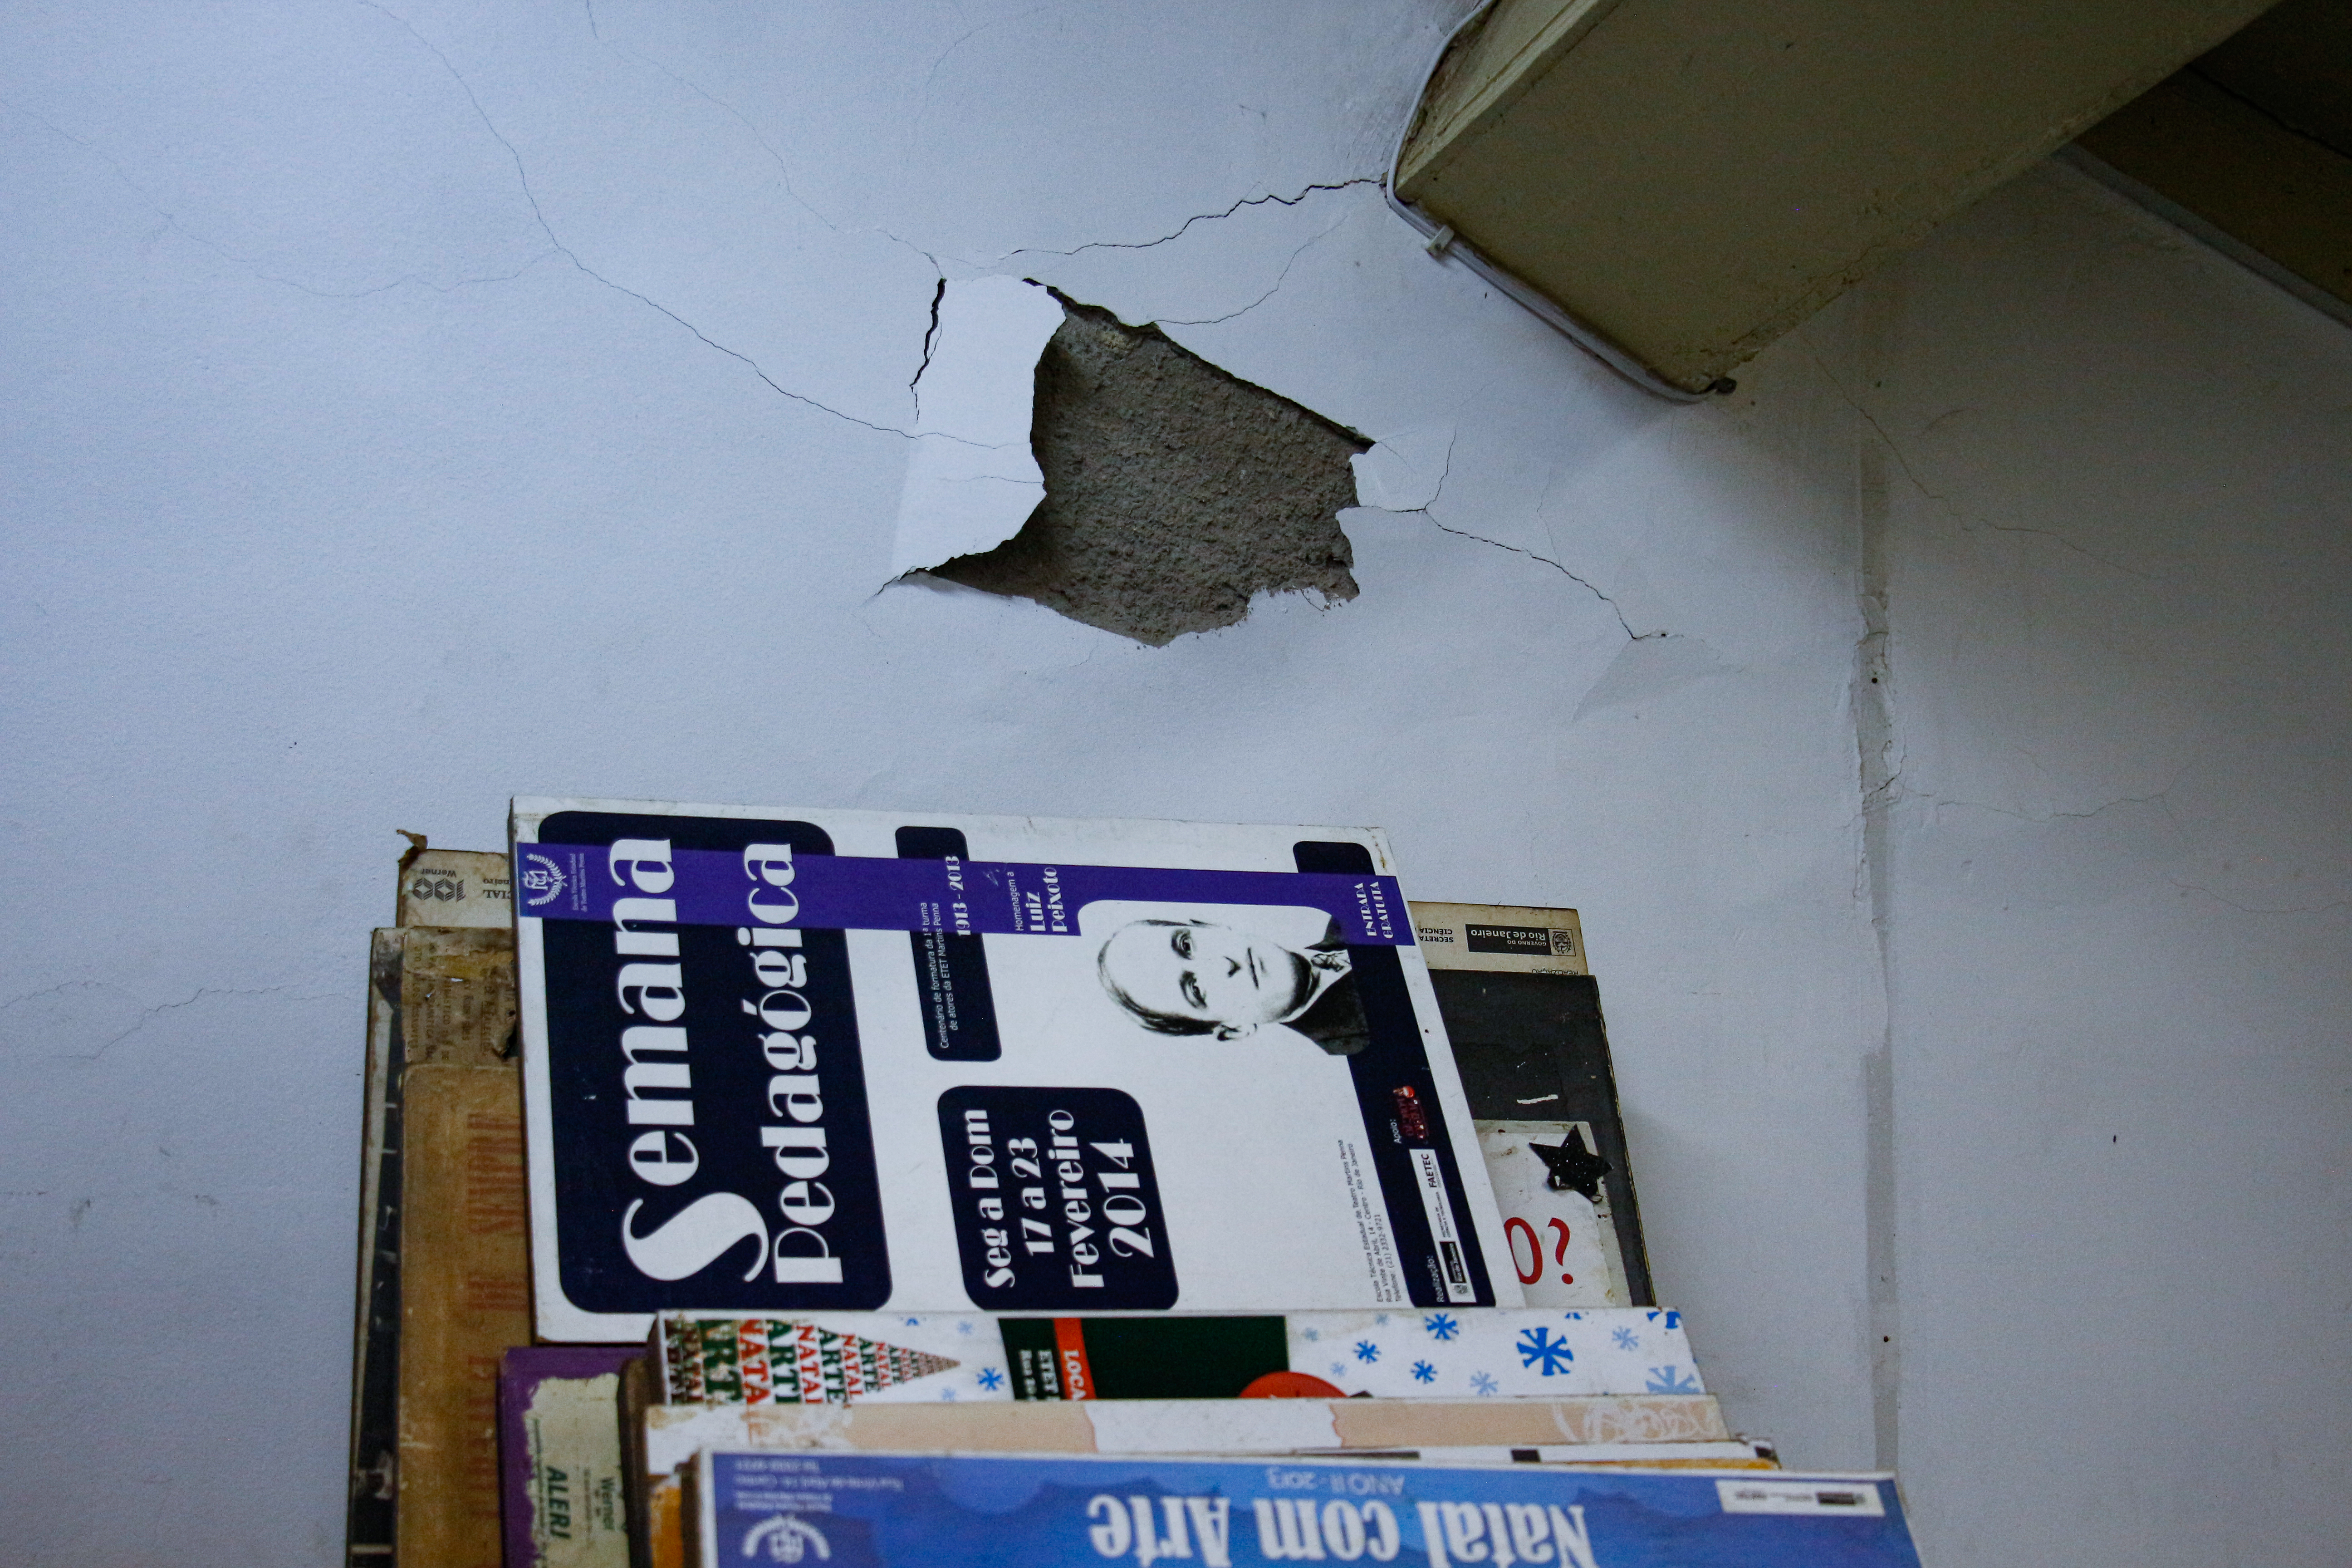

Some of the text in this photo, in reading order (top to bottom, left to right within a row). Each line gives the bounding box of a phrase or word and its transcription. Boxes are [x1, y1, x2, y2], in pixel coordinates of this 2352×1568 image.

[421, 869, 456, 877] Werner
[946, 856, 964, 891] 2013
[920, 902, 930, 925] turma
[953, 902, 971, 936] 1913
[1008, 879, 1024, 931] Homenagem
[1025, 892, 1046, 931] Luiz
[1043, 867, 1068, 932] Peixoto
[1354, 883, 1377, 936] ENTRADA
[1370, 882, 1393, 939] GRATUITA
[925, 940, 933, 949] da
[1470, 929, 1511, 939] Janeiro
[1528, 932, 1545, 941] Rio
[928, 951, 941, 990] formatura
[931, 903, 958, 1030] de atores da ETET Martins Penna
[933, 993, 942, 1002] de
[936, 1004, 949, 1049] Centenário
[609, 838, 769, 1282] Semana
[736, 842, 844, 1284] Pedagógica
[1337, 1139, 1347, 1160] Penna
[1390, 1119, 1401, 1144] Apoio:
[1347, 1143, 1358, 1166] Janeiro
[1353, 1169, 1361, 1177] de
[1421, 1154, 1437, 1188] FAETEC
[964, 1109, 1016, 1289] Seg a Dom
[1008, 1137, 1054, 1256] 17 a 23
[1046, 1109, 1105, 1288] Fevereiro
[1090, 1138, 1155, 1258] 2014
[1361, 1197, 1372, 1219] Centro
[1368, 1226, 1376, 1235] 14
[1385, 1253, 1395, 1269] (21)
[1427, 1255, 1445, 1302] Realização:
[818, 1327, 847, 1404] ARTE
[842, 1334, 863, 1400] NATAL
[879, 1342, 894, 1387] NATAL
[1038, 1350, 1059, 1394] ETET
[546, 1466, 572, 1540] ALERJ
[601, 1477, 616, 1530] Werner
[1347, 1473, 1406, 1496] ANO
[1087, 1494, 1601, 1568] Natal com Arte
